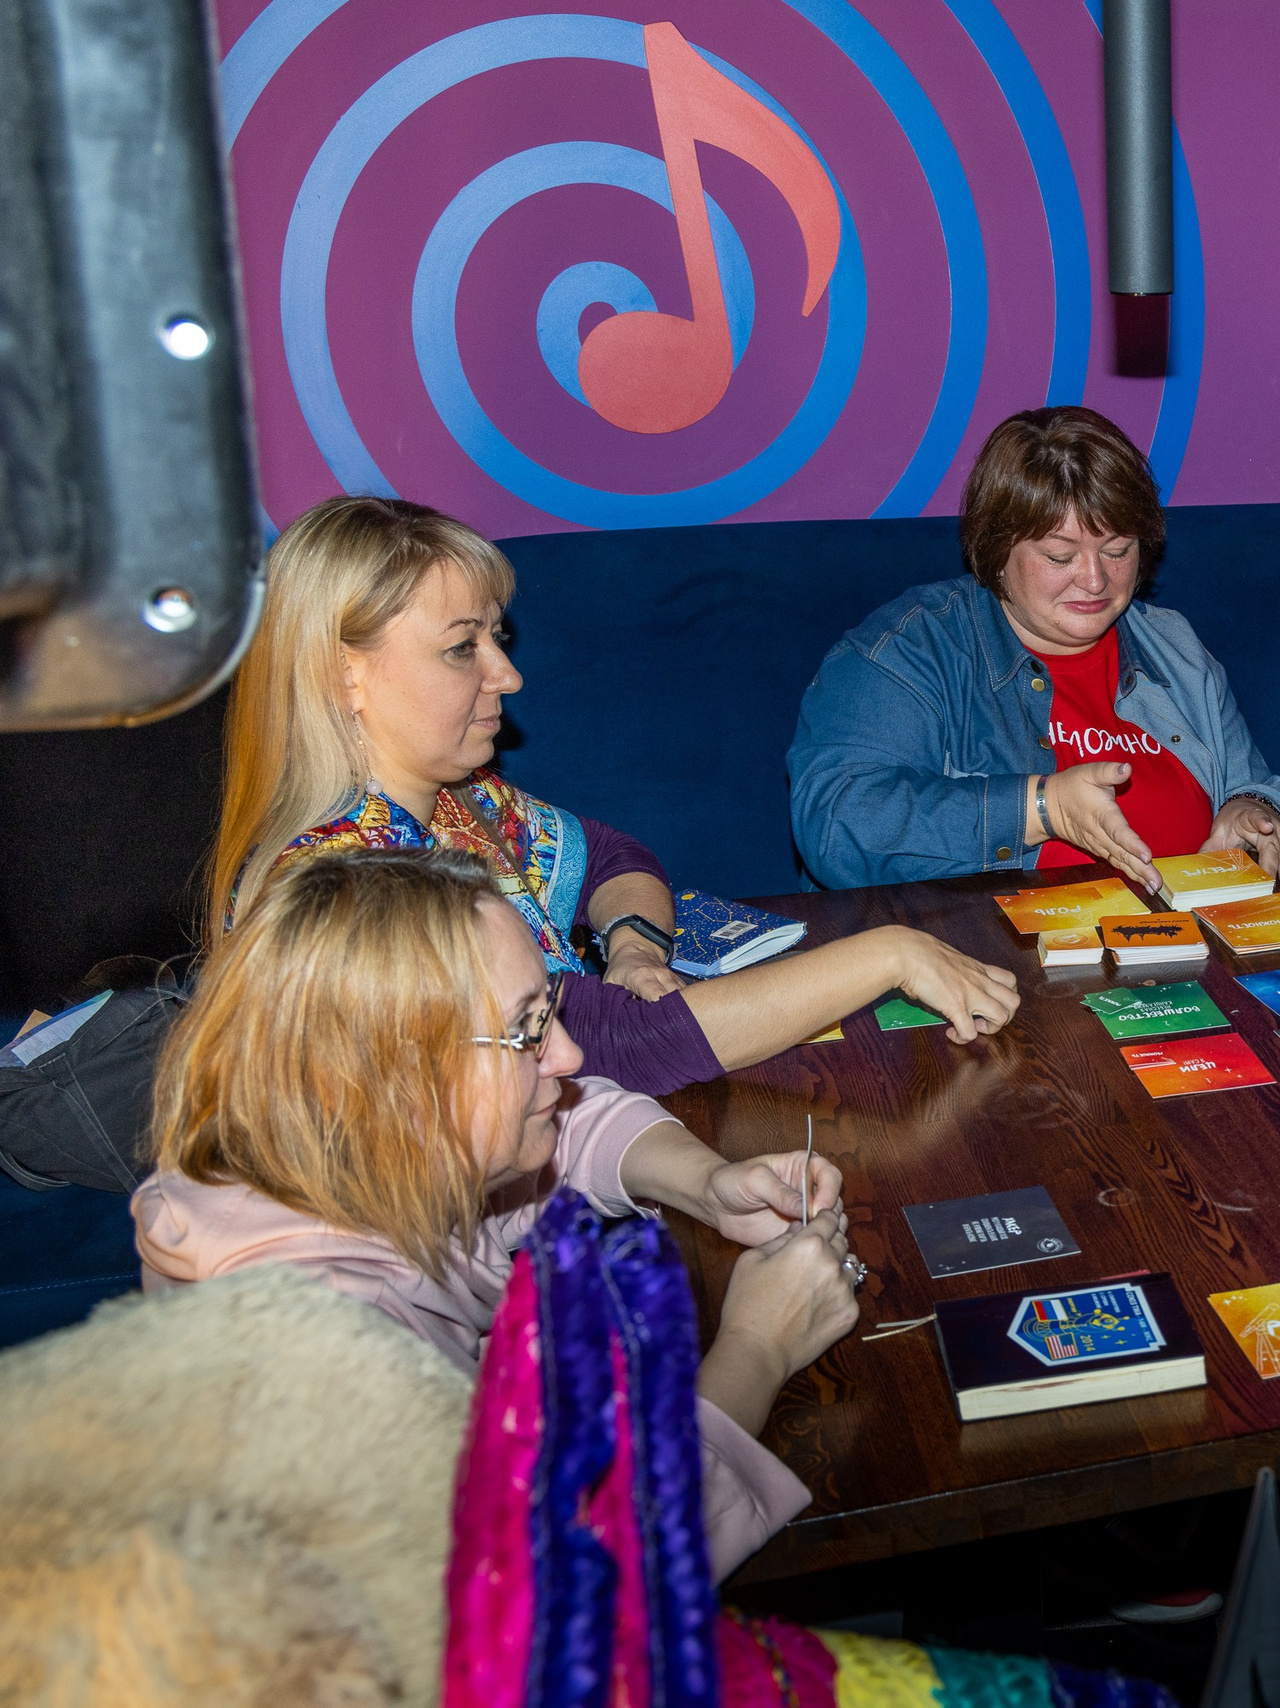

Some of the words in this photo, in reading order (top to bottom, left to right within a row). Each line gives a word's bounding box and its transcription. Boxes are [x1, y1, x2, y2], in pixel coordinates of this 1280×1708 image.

[1180, 864, 1238, 877] РЕСУРС
[1033, 904, 1083, 916] РОЛЬ
[1118, 1005, 1201, 1021] ВОЛШЕБСТВО
[1179, 1061, 1217, 1073] ЦЕЛИ
[1080, 1334, 1096, 1352] 2014
